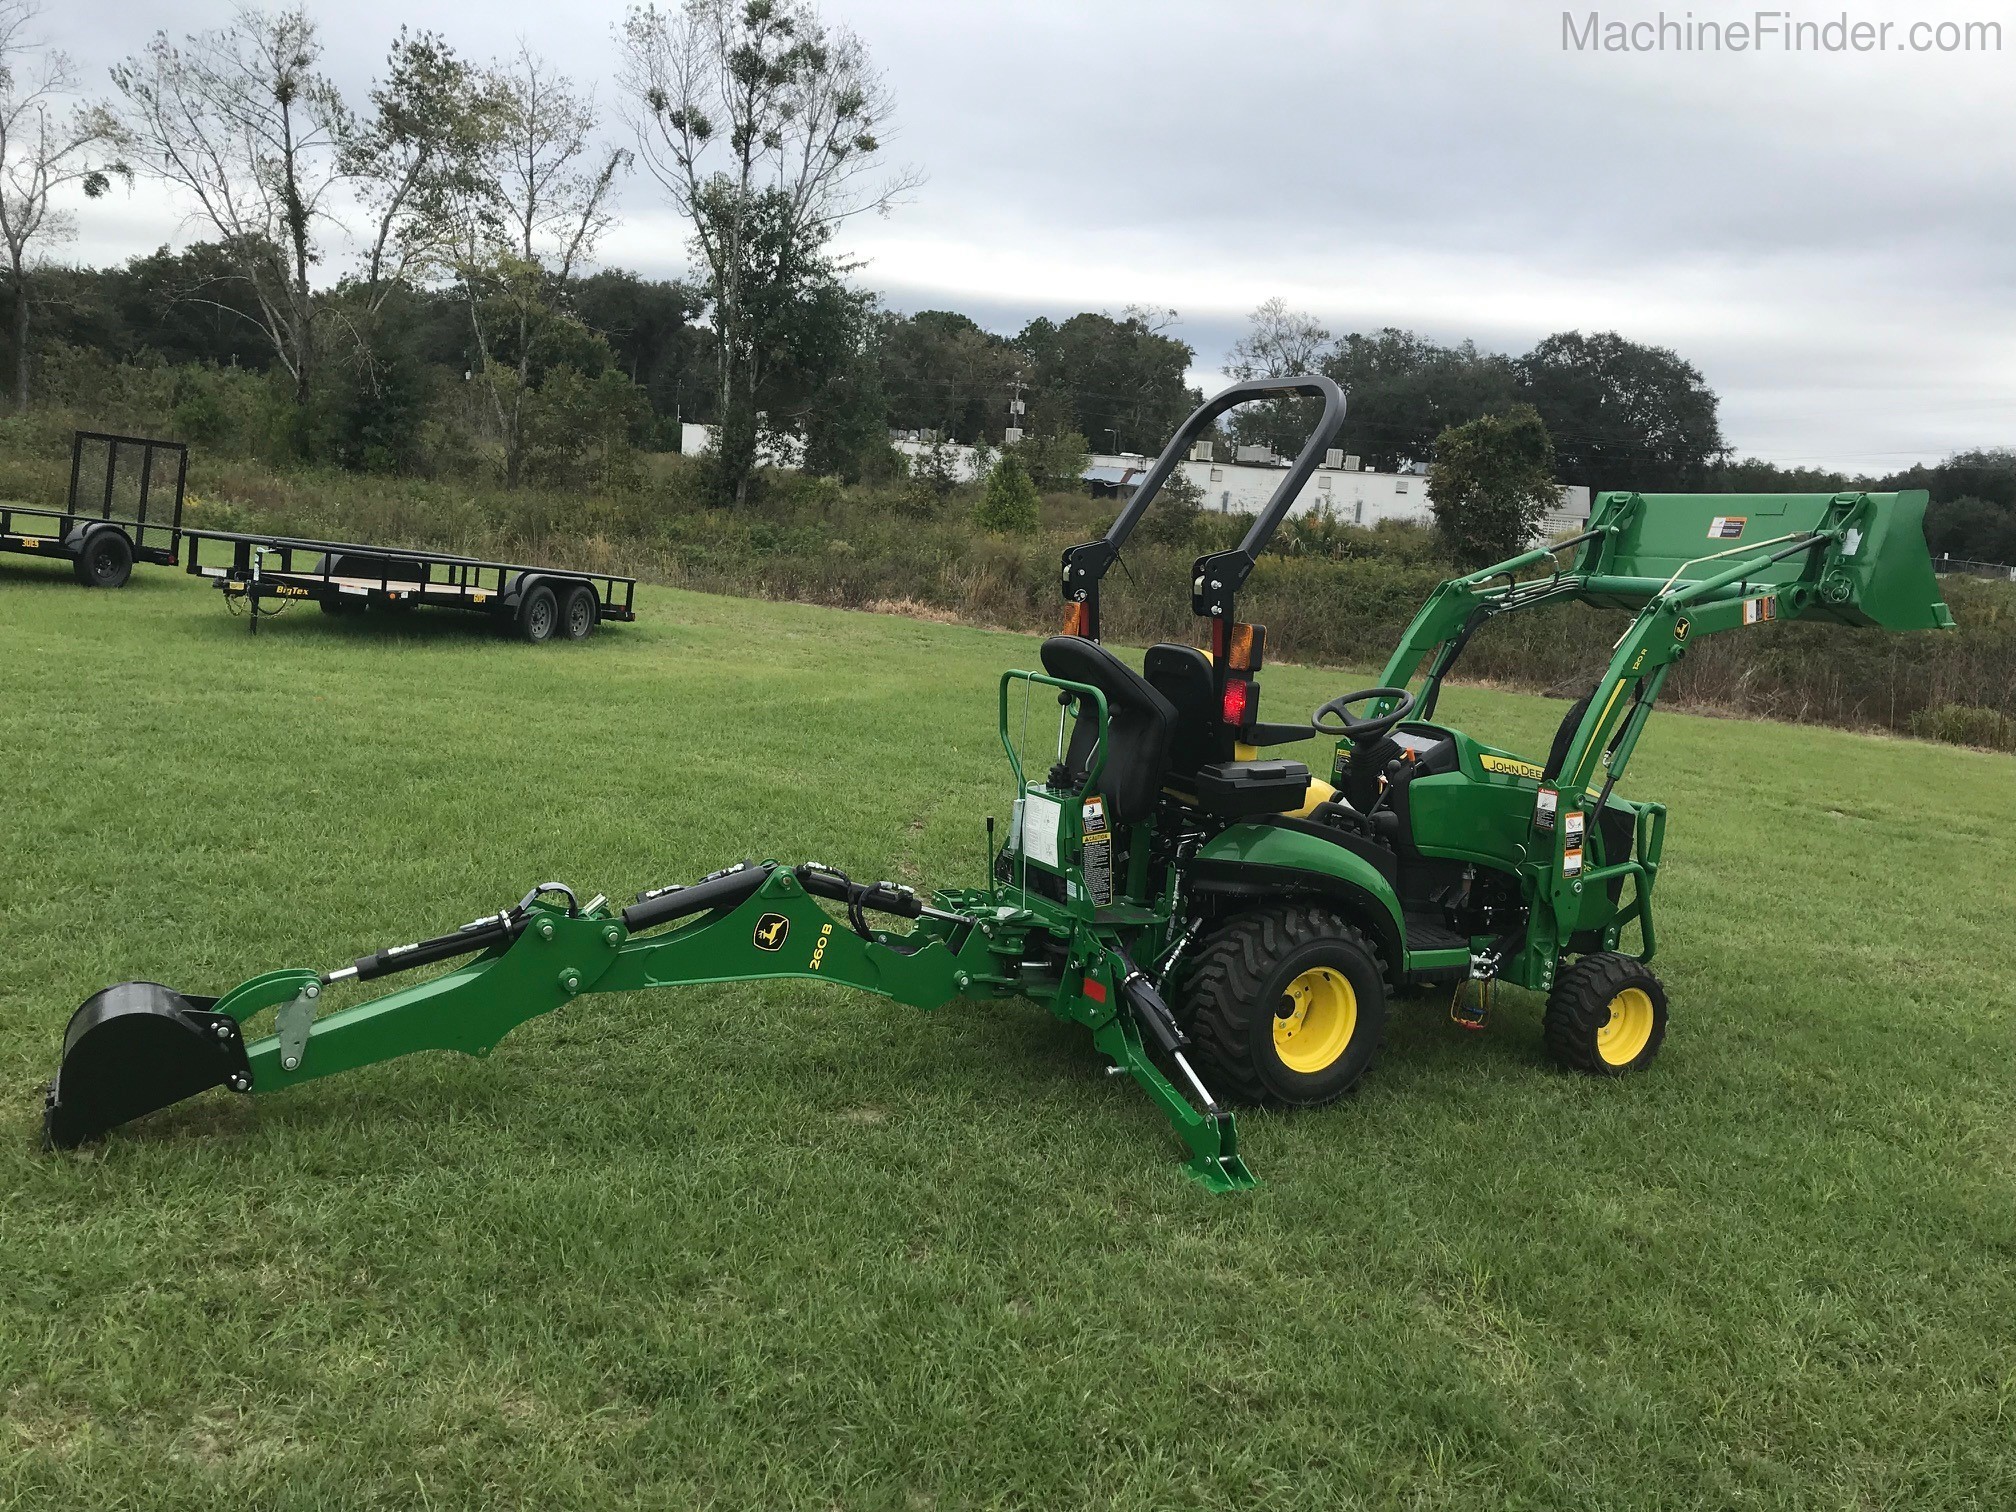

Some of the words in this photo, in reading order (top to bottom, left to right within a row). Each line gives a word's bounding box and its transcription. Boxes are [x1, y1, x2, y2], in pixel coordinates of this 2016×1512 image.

[1489, 759, 1519, 774] JOHN
[809, 936, 828, 970] 260
[821, 923, 833, 935] B
